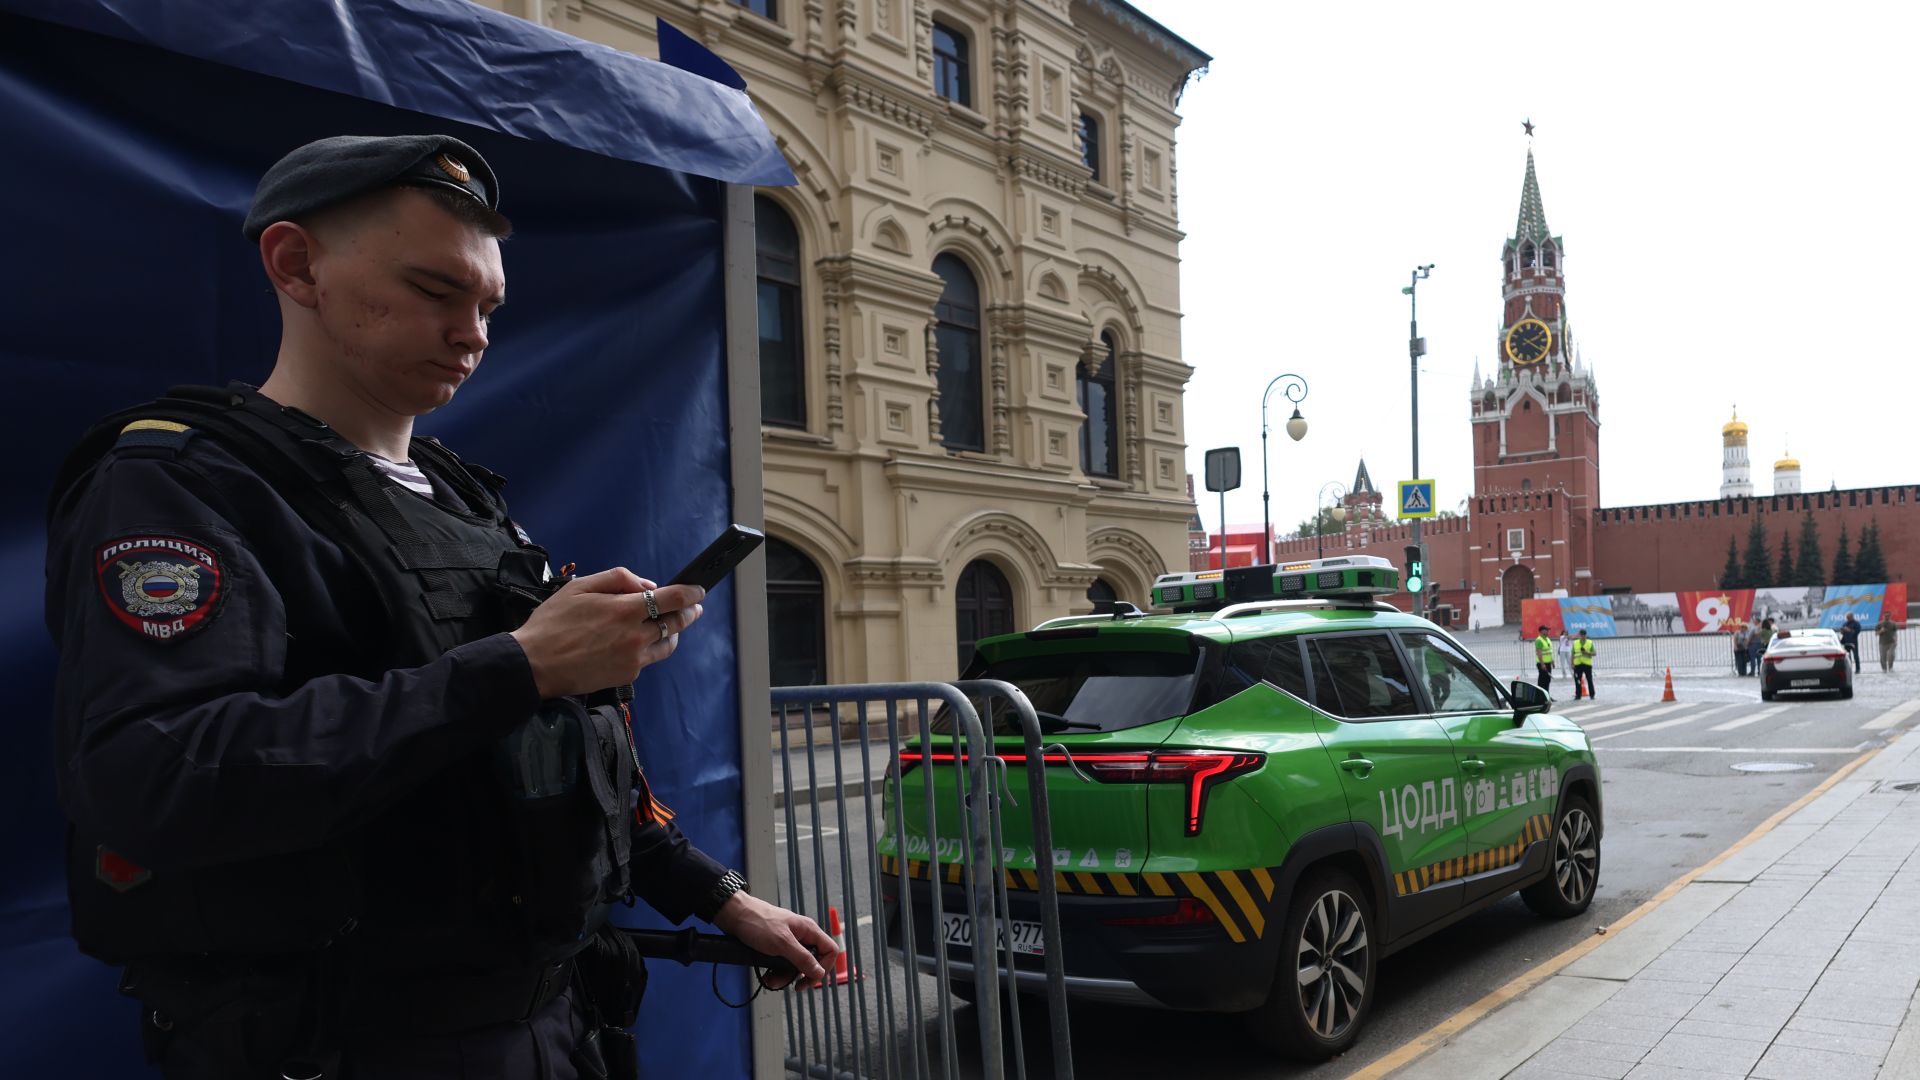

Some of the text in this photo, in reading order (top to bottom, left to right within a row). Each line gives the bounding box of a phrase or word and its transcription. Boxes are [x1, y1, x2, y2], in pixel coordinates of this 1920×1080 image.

[103, 539, 212, 566] ПОЛИЦИЯ
[1695, 597, 1730, 633] 9
[142, 619, 185, 639] МВД
[1379, 777, 1458, 841] ЦОДД
[1012, 922, 1042, 944] 977
[1017, 943, 1032, 953] RUS
